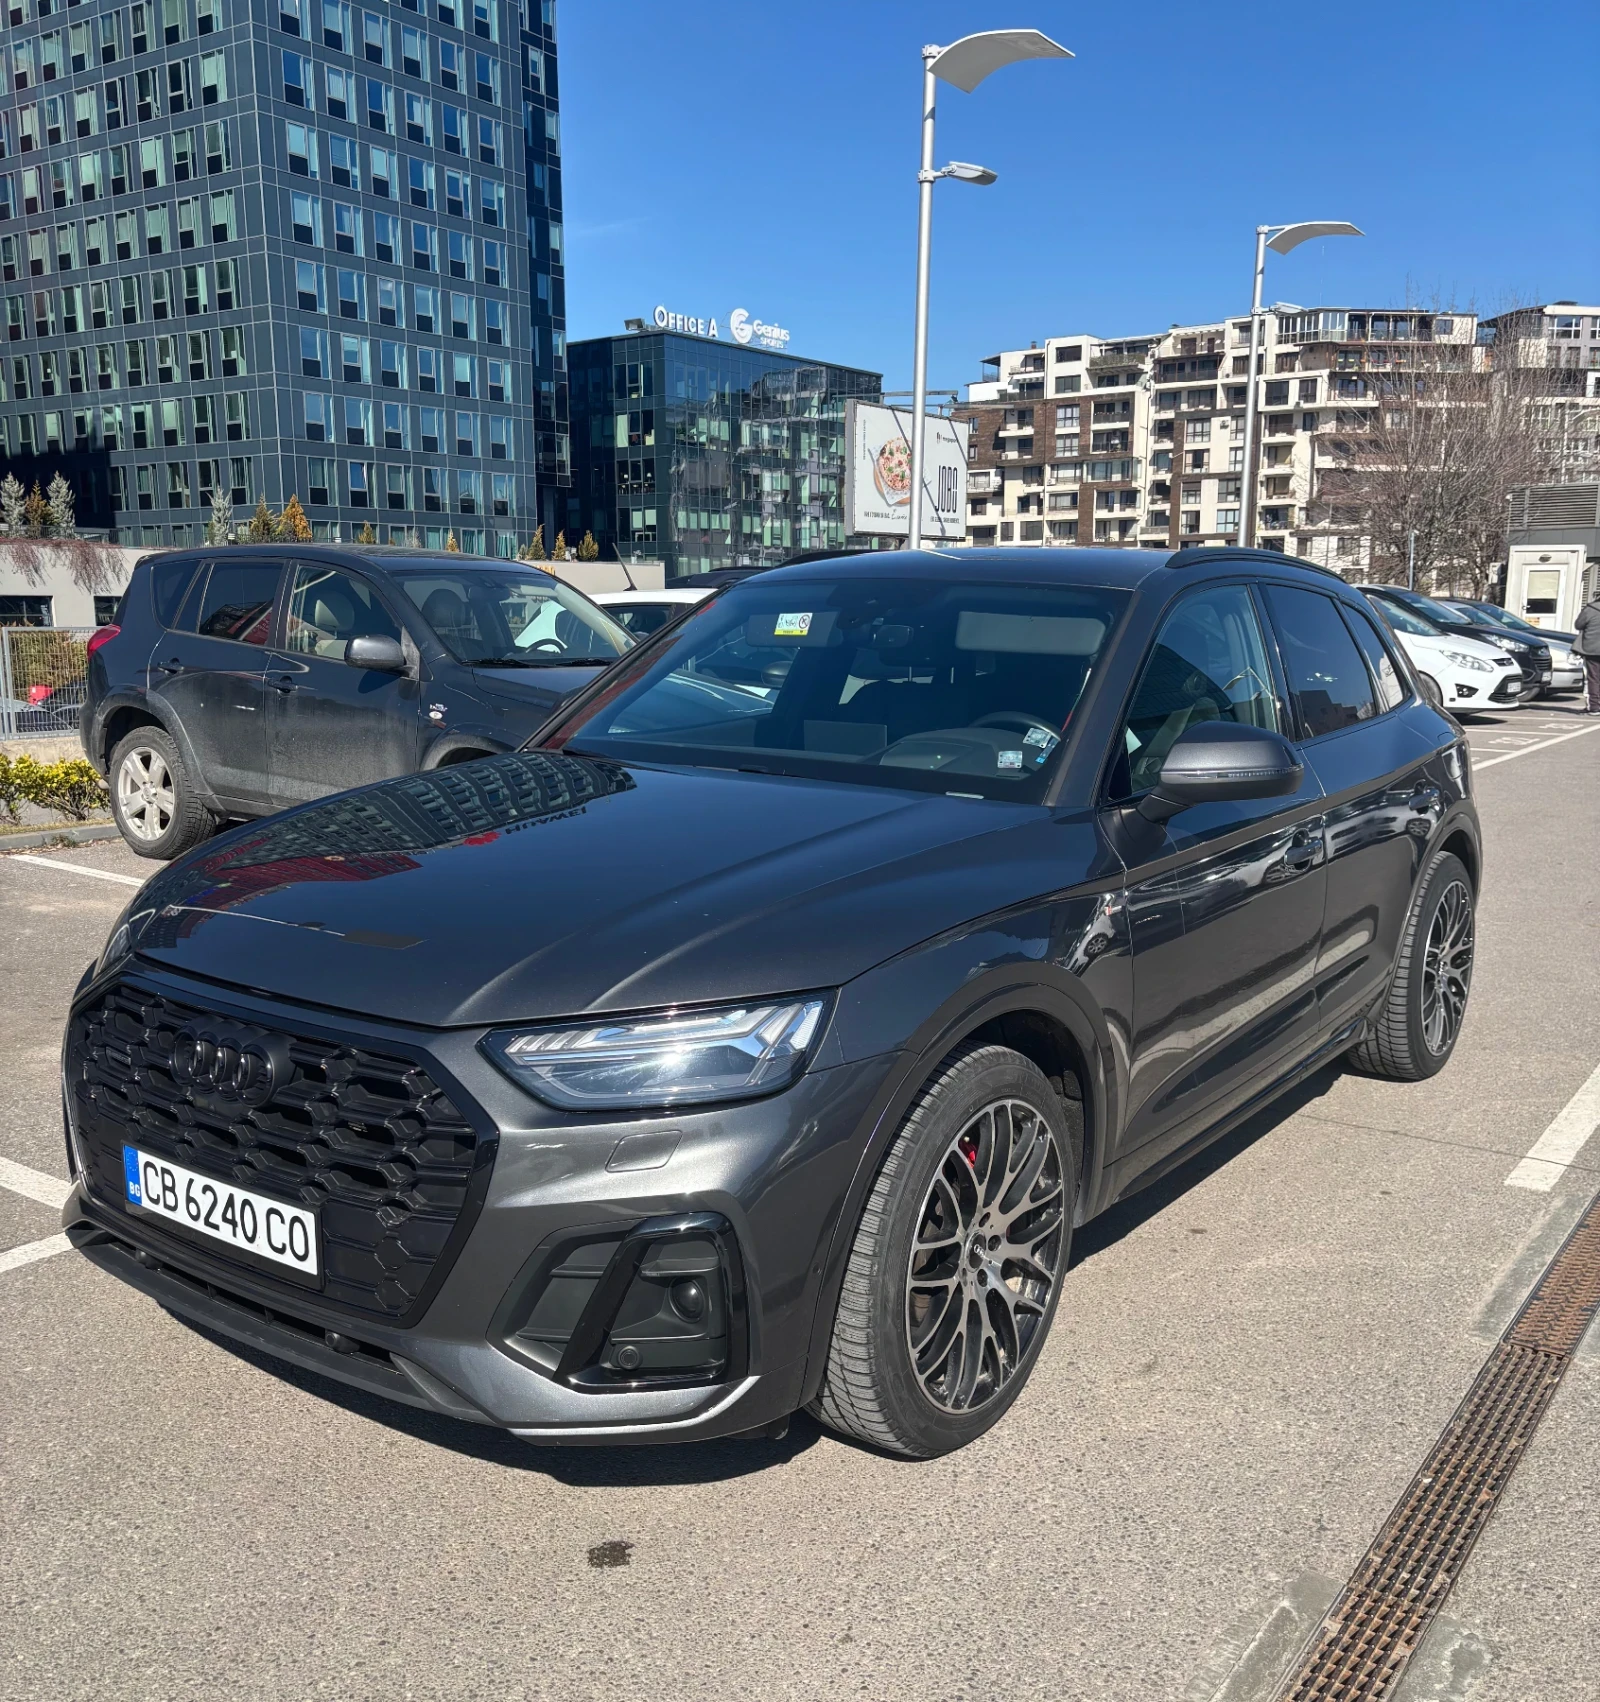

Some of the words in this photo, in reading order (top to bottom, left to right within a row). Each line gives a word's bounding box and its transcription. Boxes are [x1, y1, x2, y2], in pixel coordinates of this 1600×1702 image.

[653, 305, 705, 335] OFFICE
[707, 317, 719, 338] A
[753, 319, 790, 342] Genius
[760, 336, 785, 349] SPORTS
[129, 1181, 141, 1198] BG
[143, 1160, 179, 1212] CB
[185, 1177, 258, 1244] 6240
[265, 1206, 310, 1262] CO
